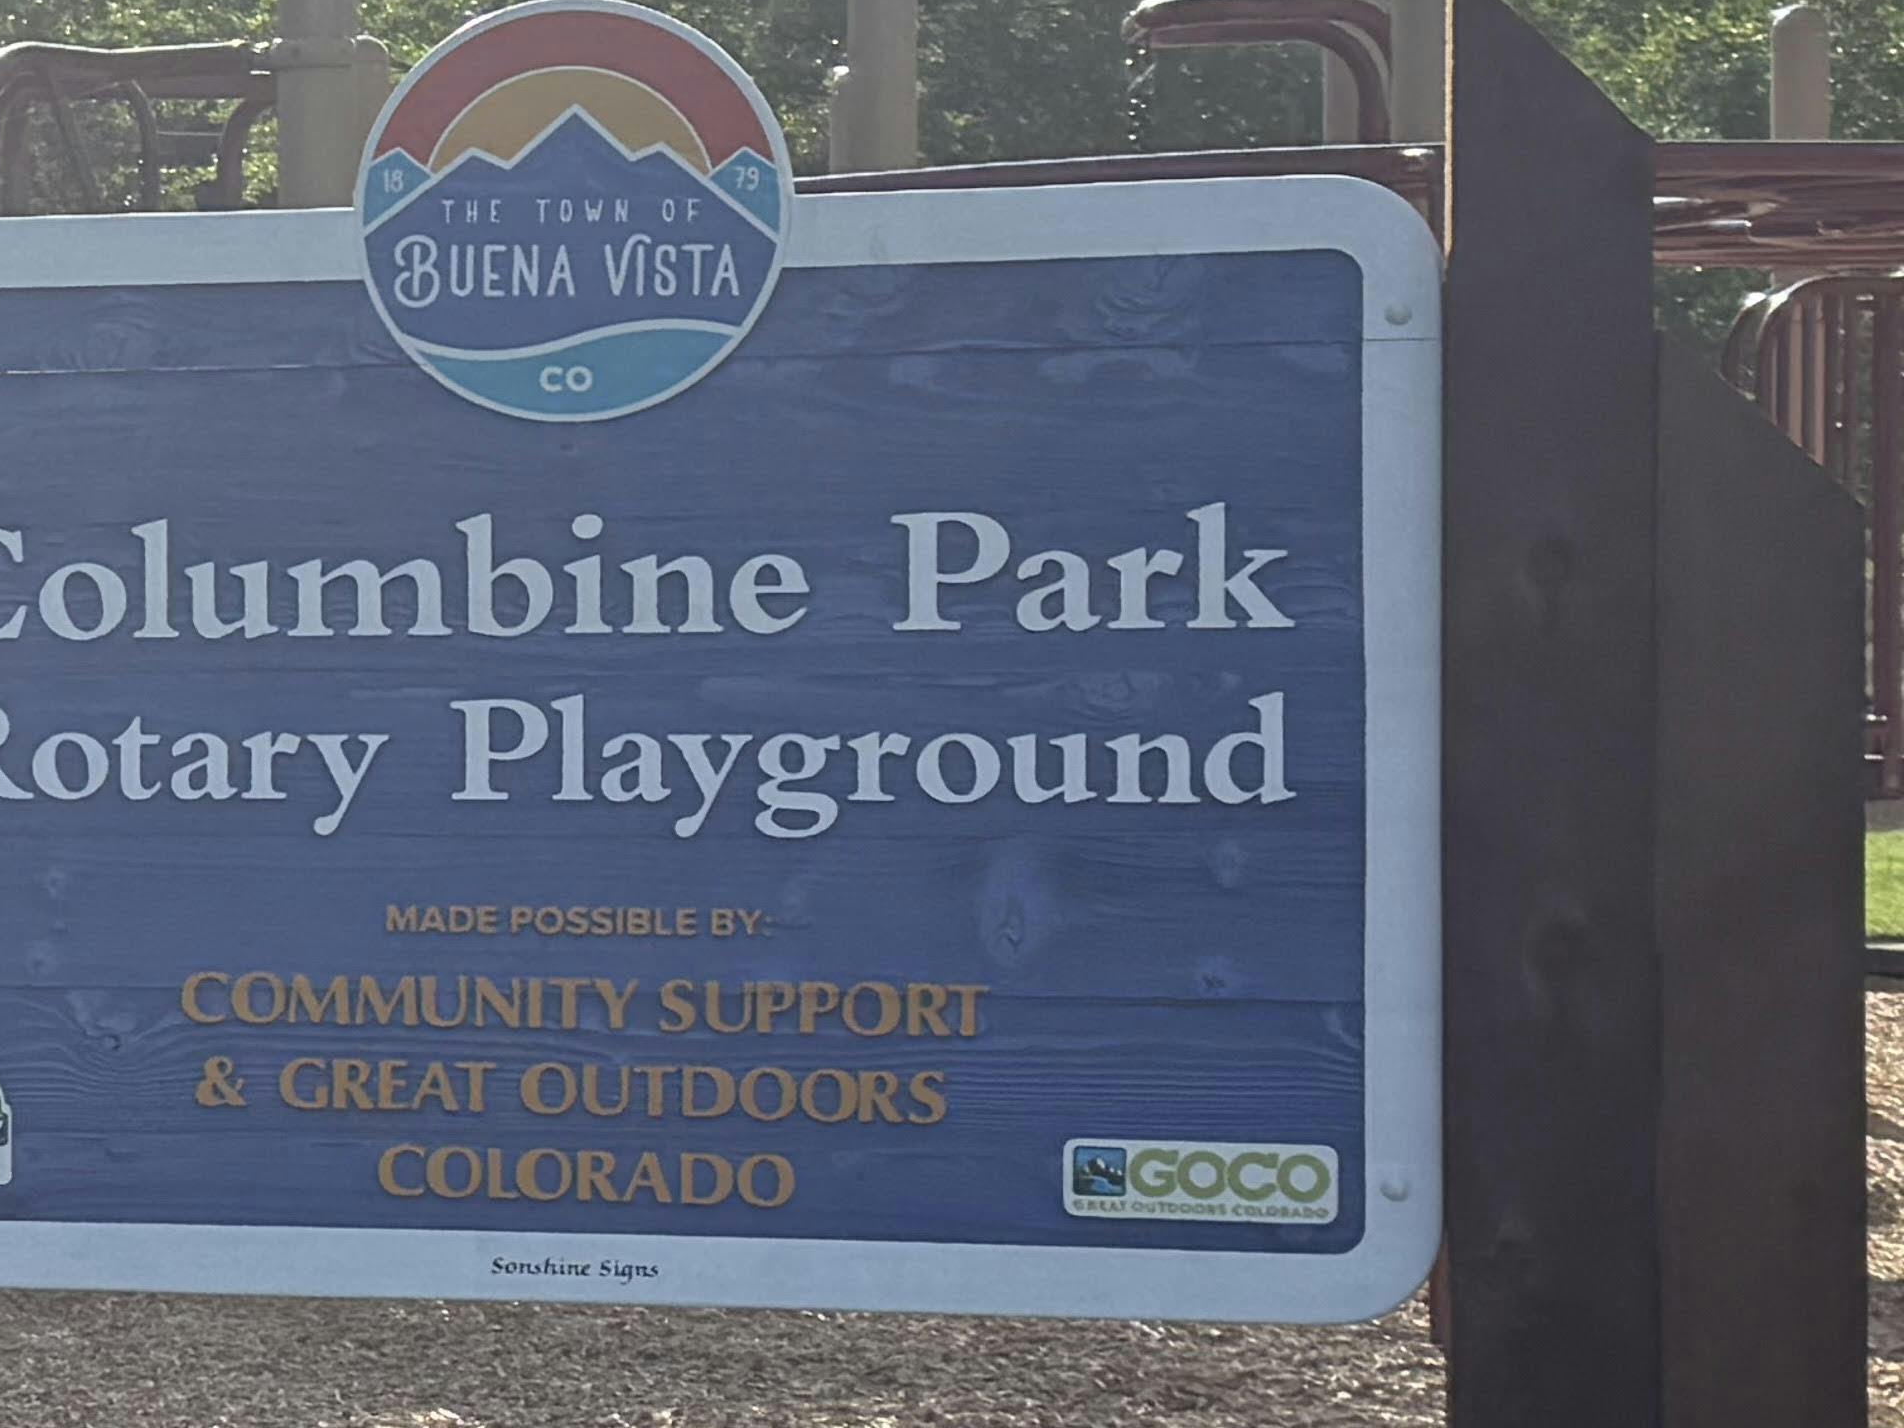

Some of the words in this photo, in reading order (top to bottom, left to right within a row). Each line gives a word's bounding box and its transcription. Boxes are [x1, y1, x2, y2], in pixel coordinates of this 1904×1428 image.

[382, 168, 405, 193] 18
[734, 167, 760, 191] 79
[441, 198, 502, 224] THE
[536, 198, 629, 224] TOWN
[661, 198, 701, 223] OF
[393, 234, 576, 308] BUENA
[604, 233, 740, 297] VISTA
[539, 365, 593, 393] CO
[890, 501, 1296, 632] Park
[449, 691, 1297, 838] Playground
[385, 904, 498, 934] MADE
[510, 905, 697, 936] POSSIBLE
[710, 907, 773, 937] BY:
[181, 970, 638, 1029] COMMUNITY
[659, 978, 990, 1037] SUPPORT
[195, 1055, 247, 1107] &
[279, 1057, 497, 1112] GREAT
[519, 1061, 946, 1124] OUTDOORS
[378, 1142, 796, 1207] COLORADO
[1129, 1148, 1331, 1203] GOCO
[1131, 1202, 1226, 1216] OUTDOORS
[1231, 1204, 1329, 1219] COLORADO
[492, 1256, 591, 1277] Sonshine
[599, 1259, 660, 1286] Signs
